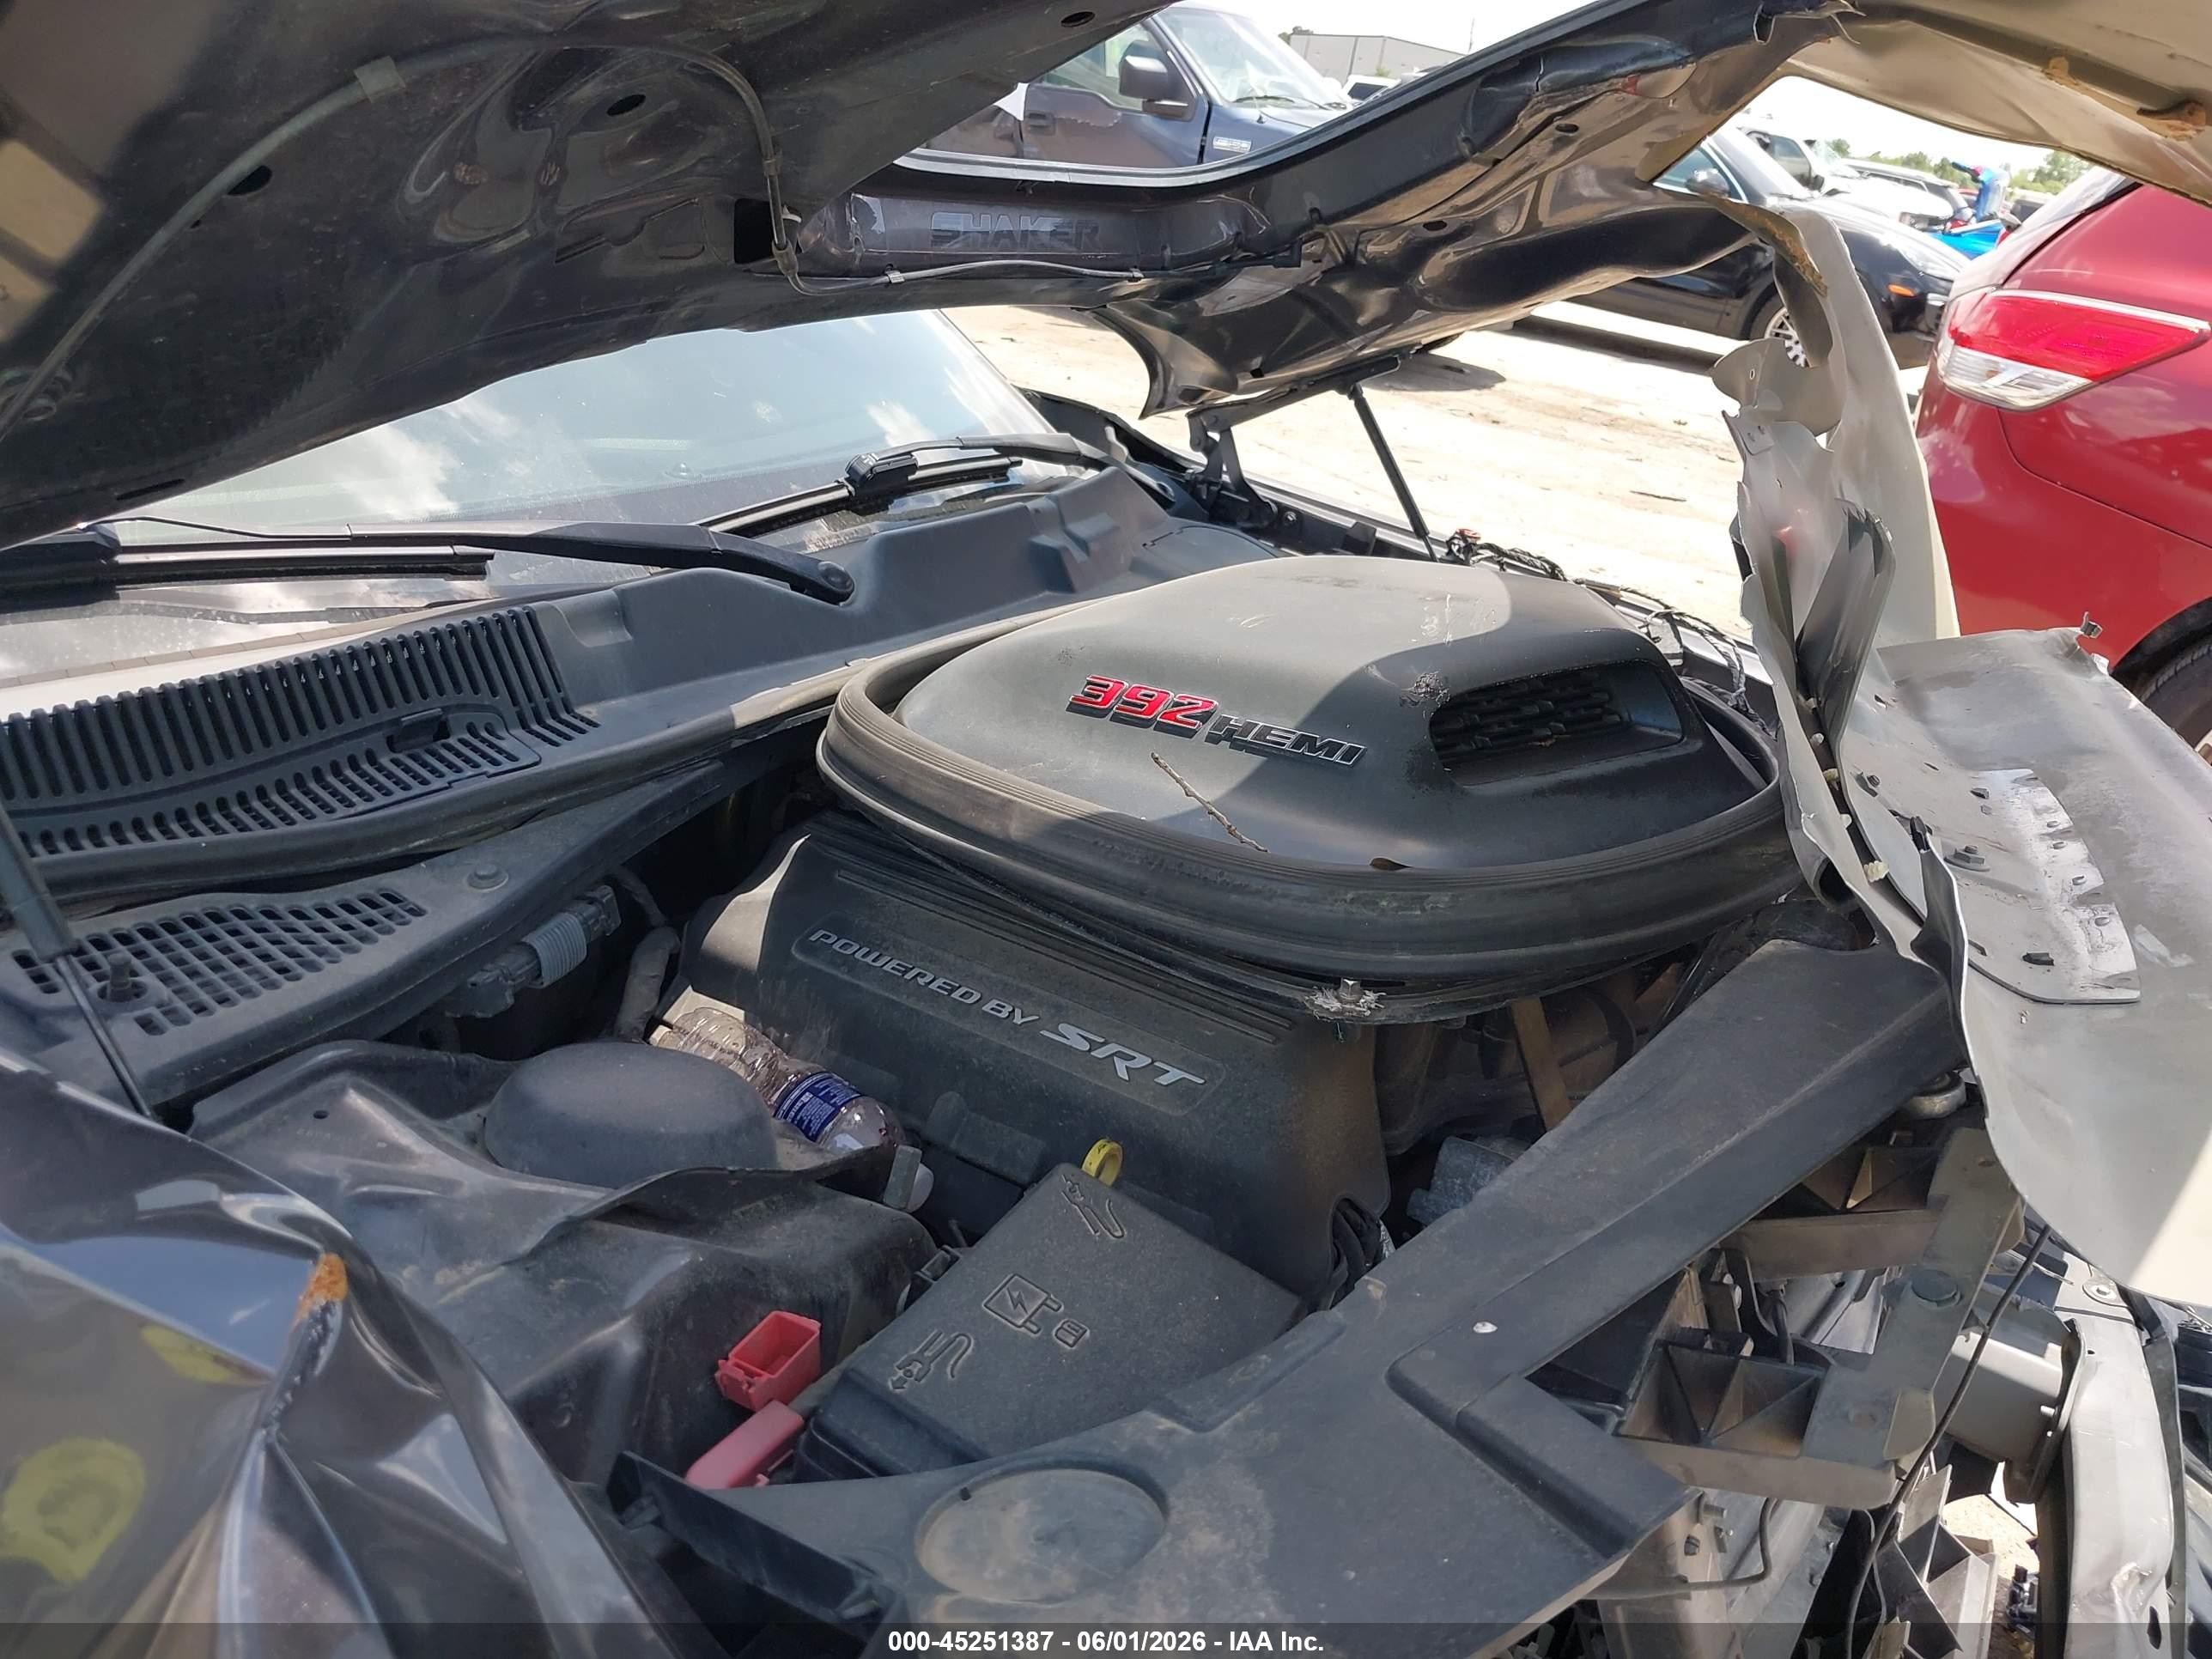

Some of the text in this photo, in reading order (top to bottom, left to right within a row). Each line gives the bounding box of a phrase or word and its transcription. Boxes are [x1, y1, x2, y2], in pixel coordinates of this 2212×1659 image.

[931, 211, 1102, 250] SHAKER
[1067, 674, 1367, 766] 392 HEMI
[809, 929, 1206, 1085] POWERED BY SRT
